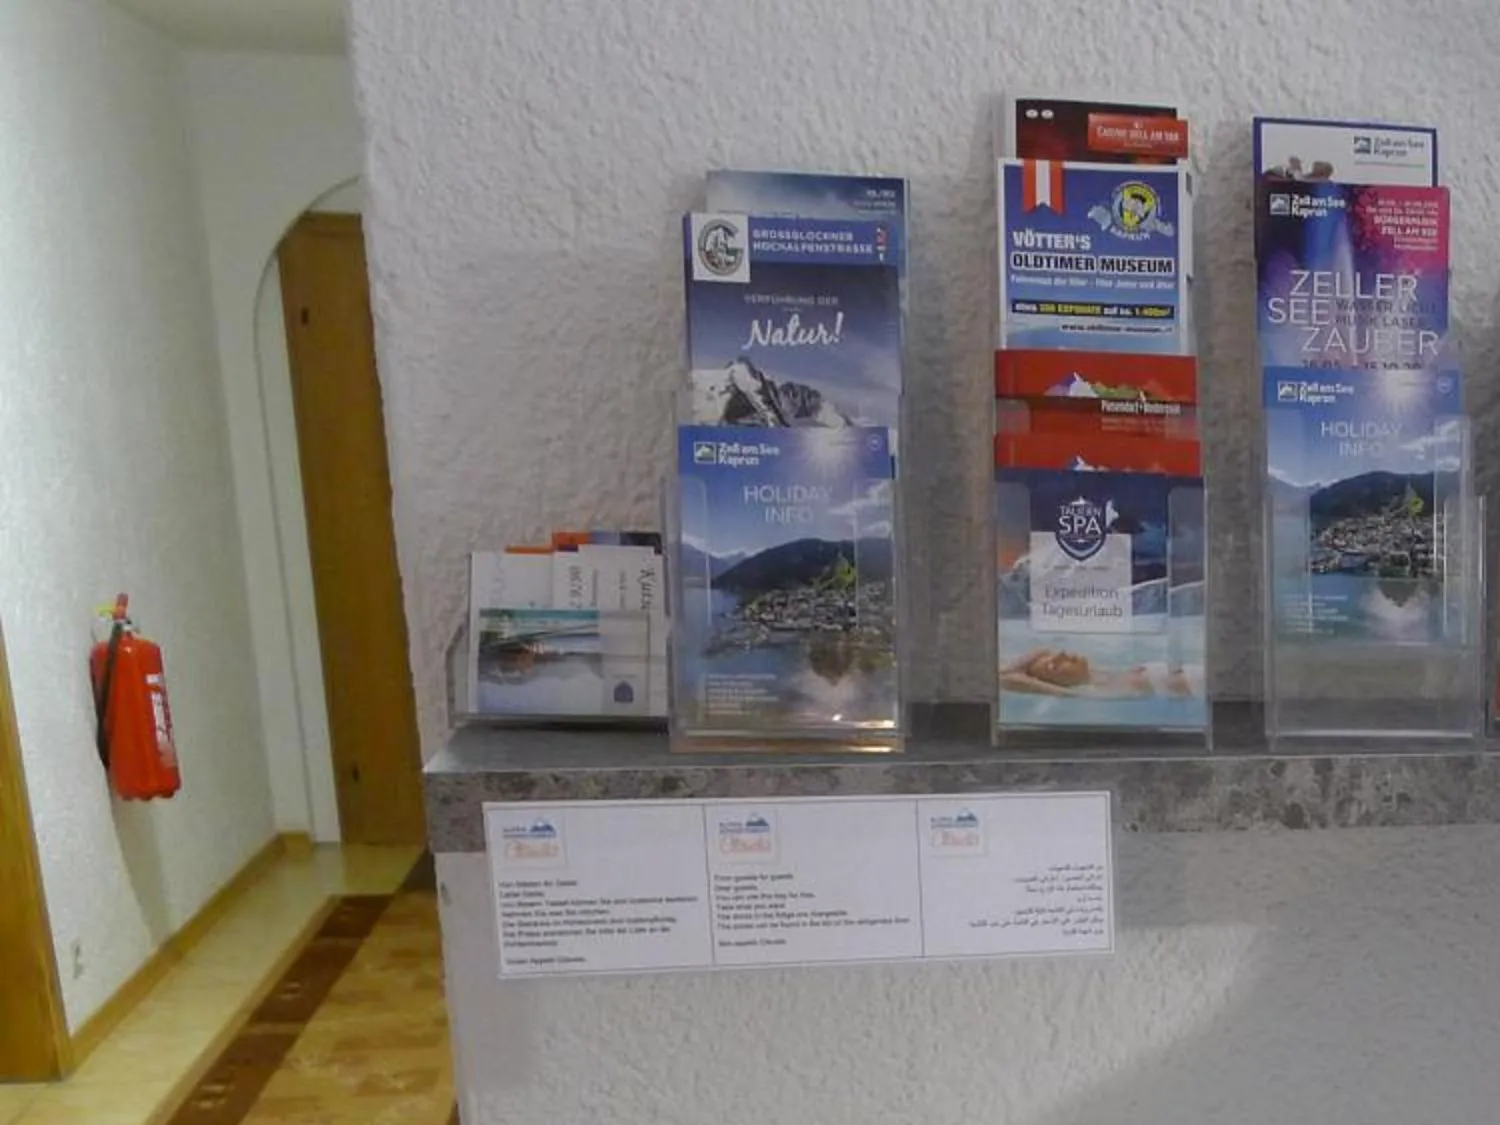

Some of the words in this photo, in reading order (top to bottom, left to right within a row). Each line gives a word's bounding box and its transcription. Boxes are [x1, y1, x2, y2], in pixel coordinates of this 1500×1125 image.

[1291, 194, 1311, 206] Zell
[1012, 253, 1096, 271] OLDTIMER
[1100, 258, 1174, 274] MUSEUM
[1289, 269, 1418, 301] ZELLER
[1267, 297, 1331, 326] SEE
[741, 311, 844, 350] Natur!
[1301, 327, 1440, 357] ZAUBER
[1320, 420, 1403, 438] HOLIDAY
[718, 442, 738, 454] Zell
[1339, 441, 1385, 457] INFO
[718, 454, 760, 469] Kaprun
[743, 485, 832, 505] HOLIDAY
[765, 506, 815, 527] INFO
[1058, 515, 1103, 536] SPA
